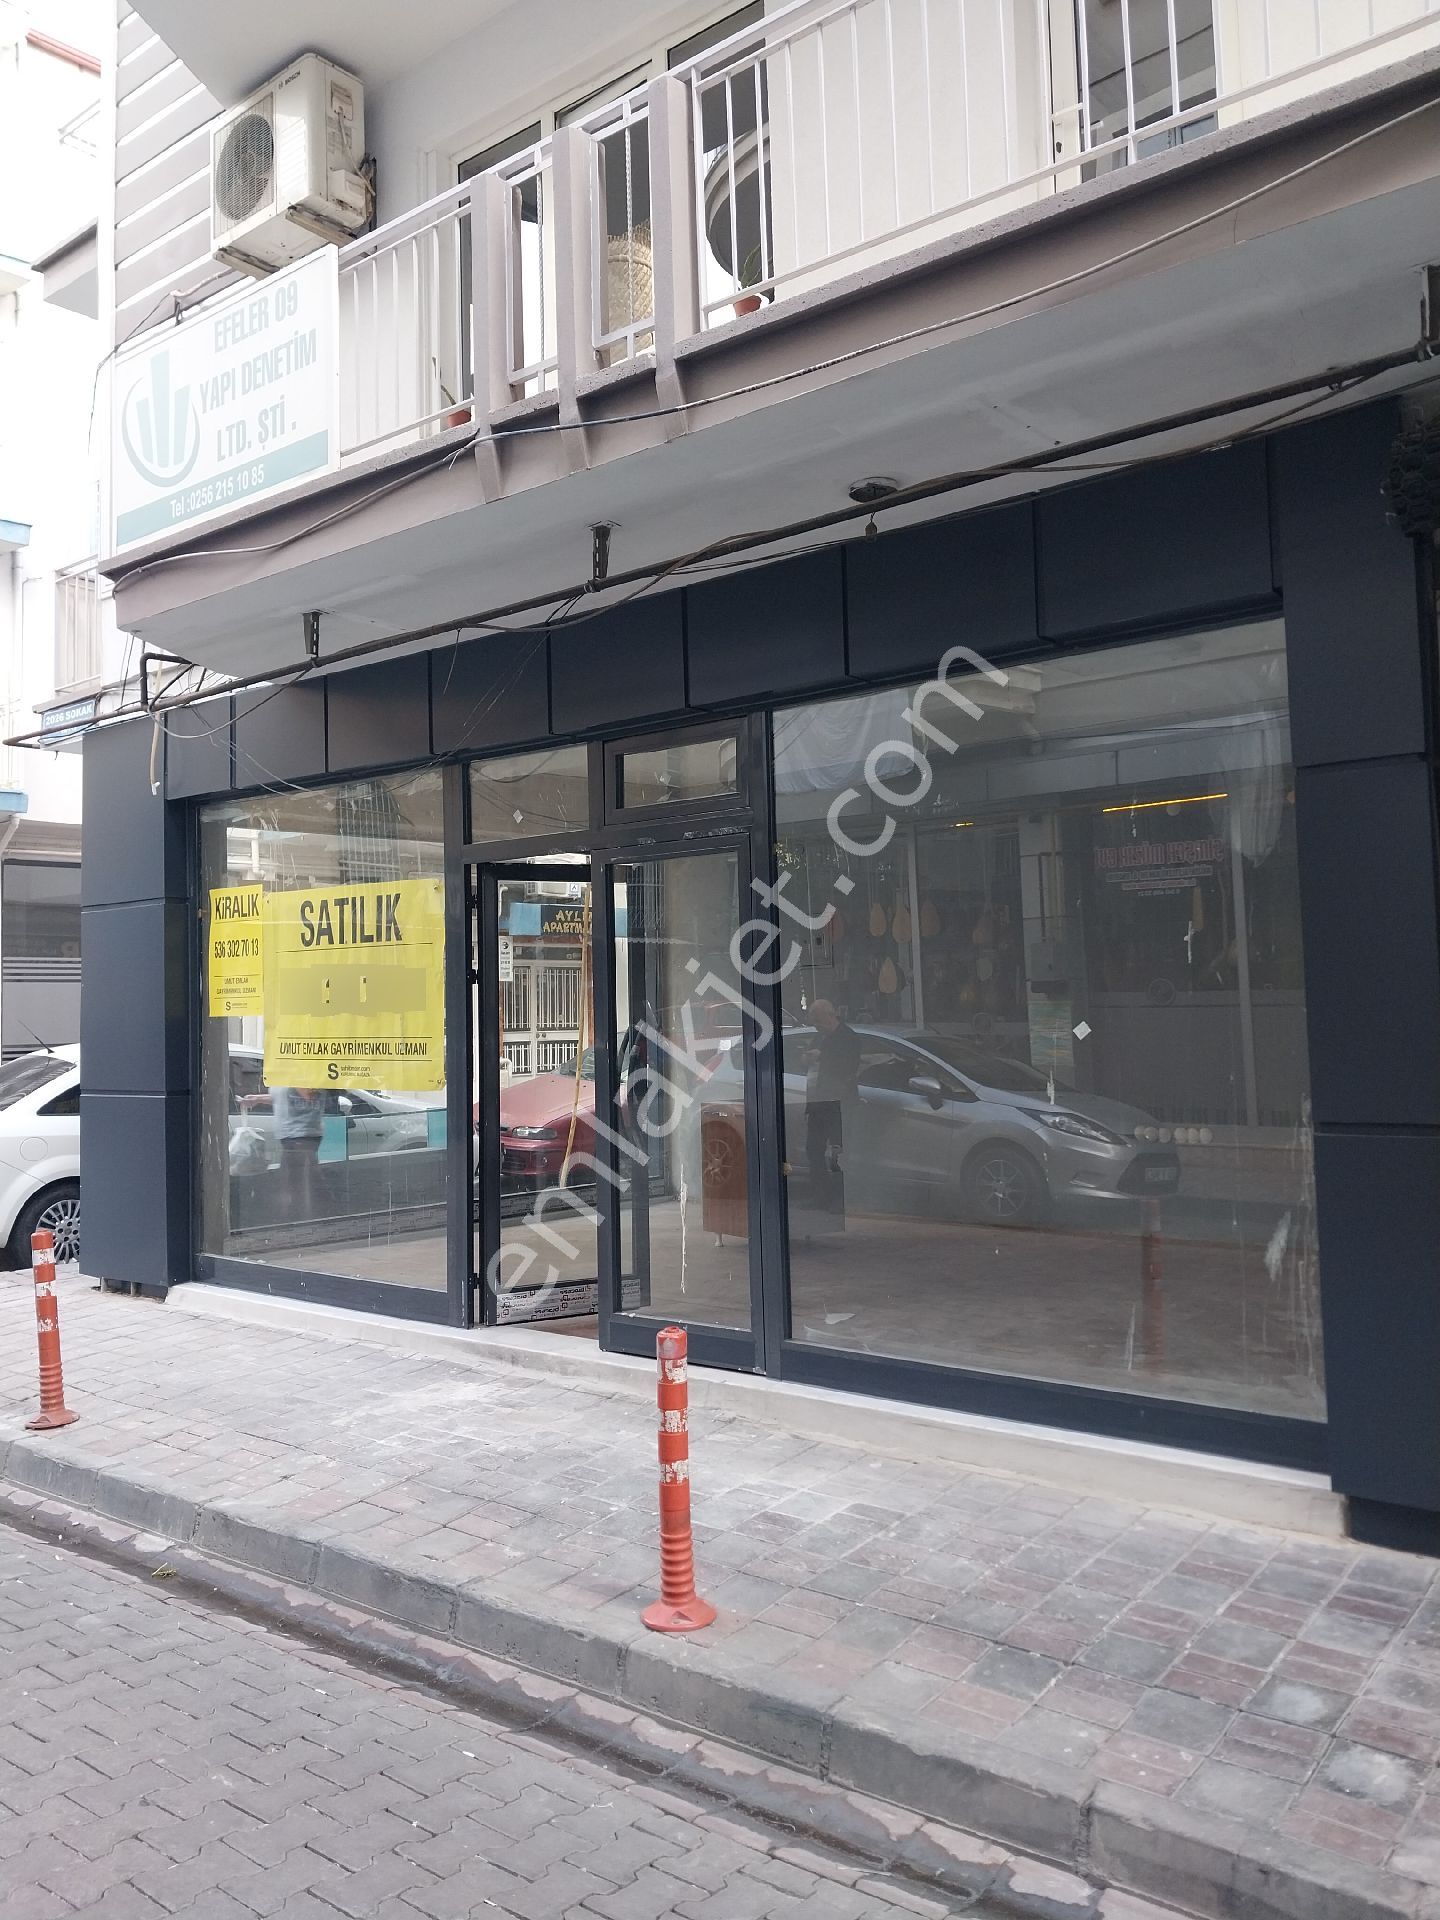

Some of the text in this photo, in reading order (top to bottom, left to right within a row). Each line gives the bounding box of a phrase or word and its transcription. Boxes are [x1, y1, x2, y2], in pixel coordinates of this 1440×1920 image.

[213, 280, 298, 353] EFELER 09
[200, 327, 317, 414] YAPI DENETİM
[217, 417, 252, 463] LTD.
[215, 476, 234, 502] 215
[236, 471, 249, 494] 10
[251, 463, 265, 487] 85
[65, 704, 93, 720] SOKAK
[300, 893, 403, 947] SATILIK
[543, 921, 590, 934] APARTM
[214, 937, 259, 959] 536 302 70 13
[279, 1040, 428, 1056] UMUT EMLAK GAYRİMENKUL UZMANI
[327, 1063, 339, 1081] S
